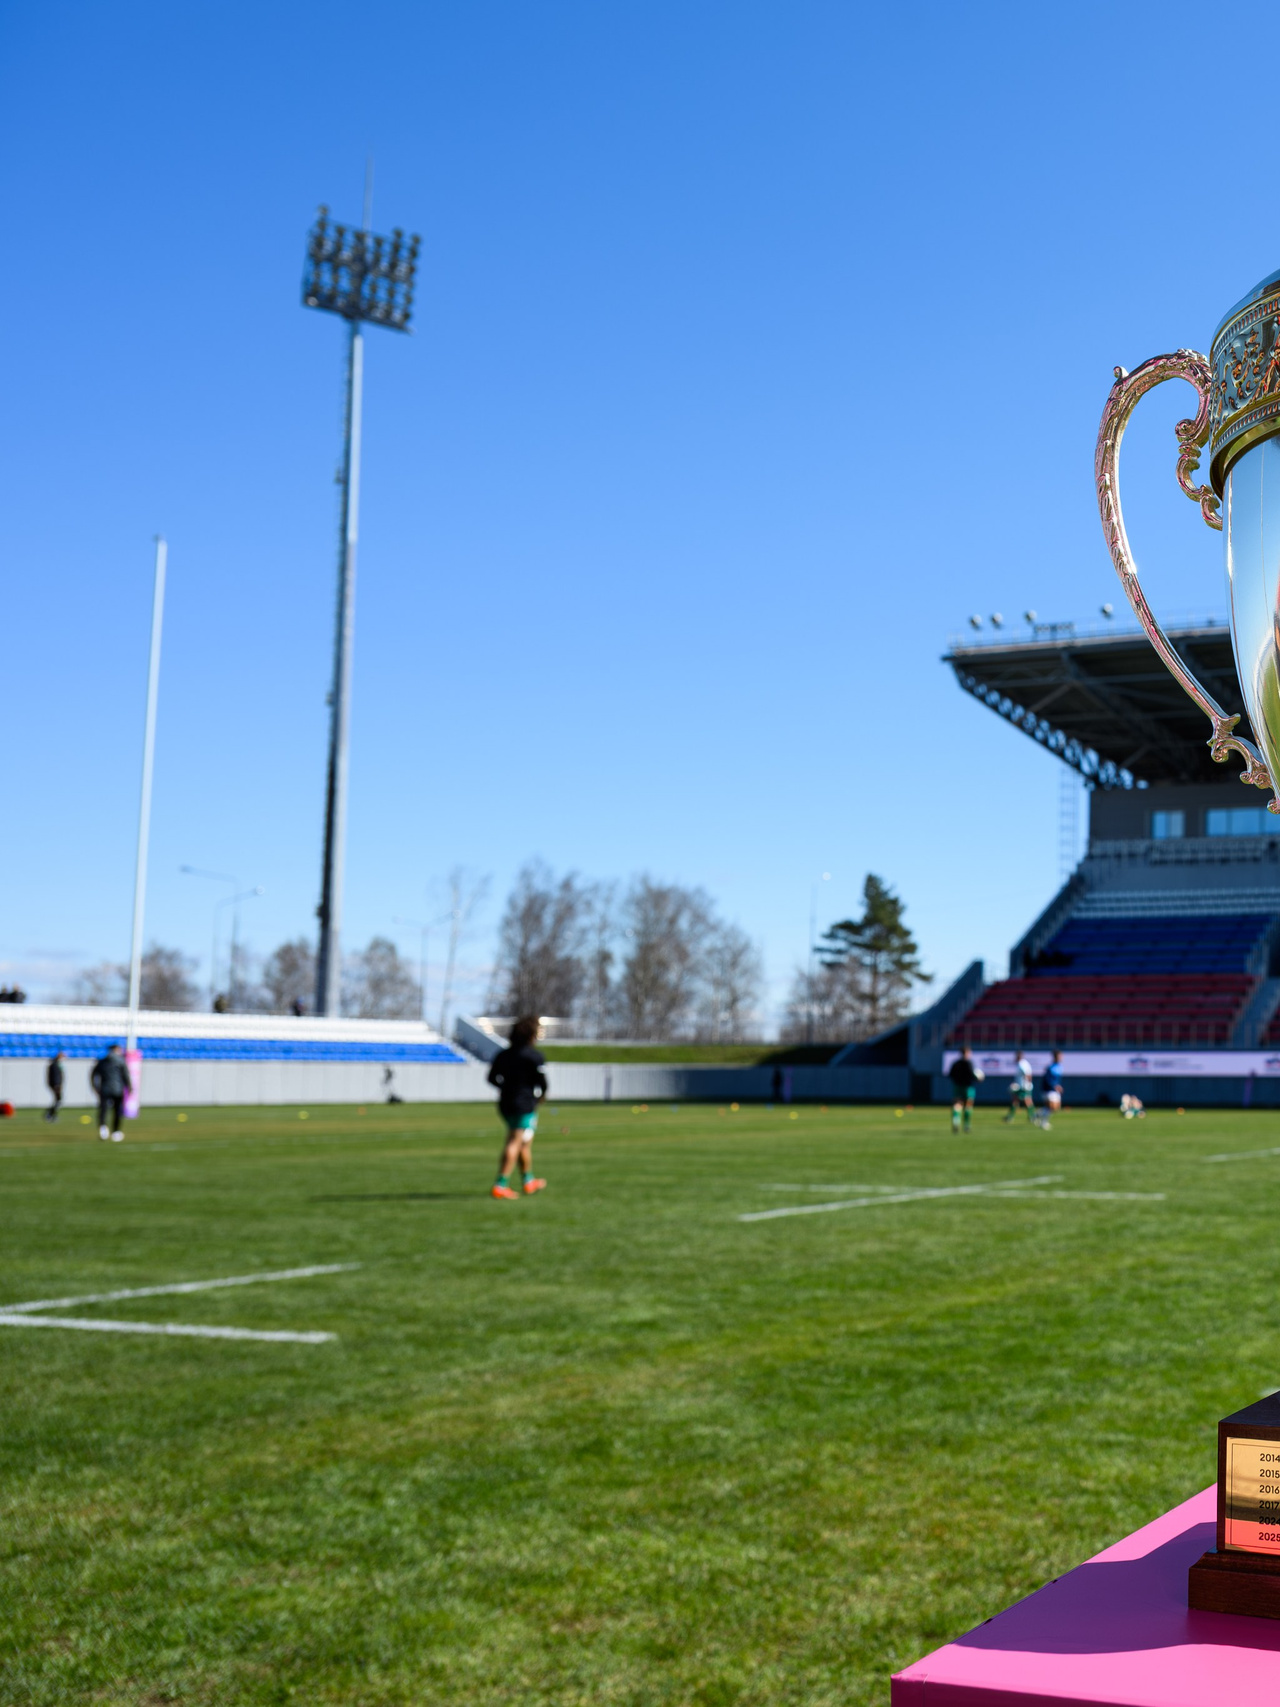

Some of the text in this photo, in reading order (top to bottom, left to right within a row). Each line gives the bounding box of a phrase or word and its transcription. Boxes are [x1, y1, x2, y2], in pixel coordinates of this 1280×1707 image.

[1260, 1453, 1280, 1462] 2014
[1259, 1469, 1280, 1478] 2015
[1259, 1484, 1280, 1494] 2016
[1259, 1500, 1280, 1510] 2017
